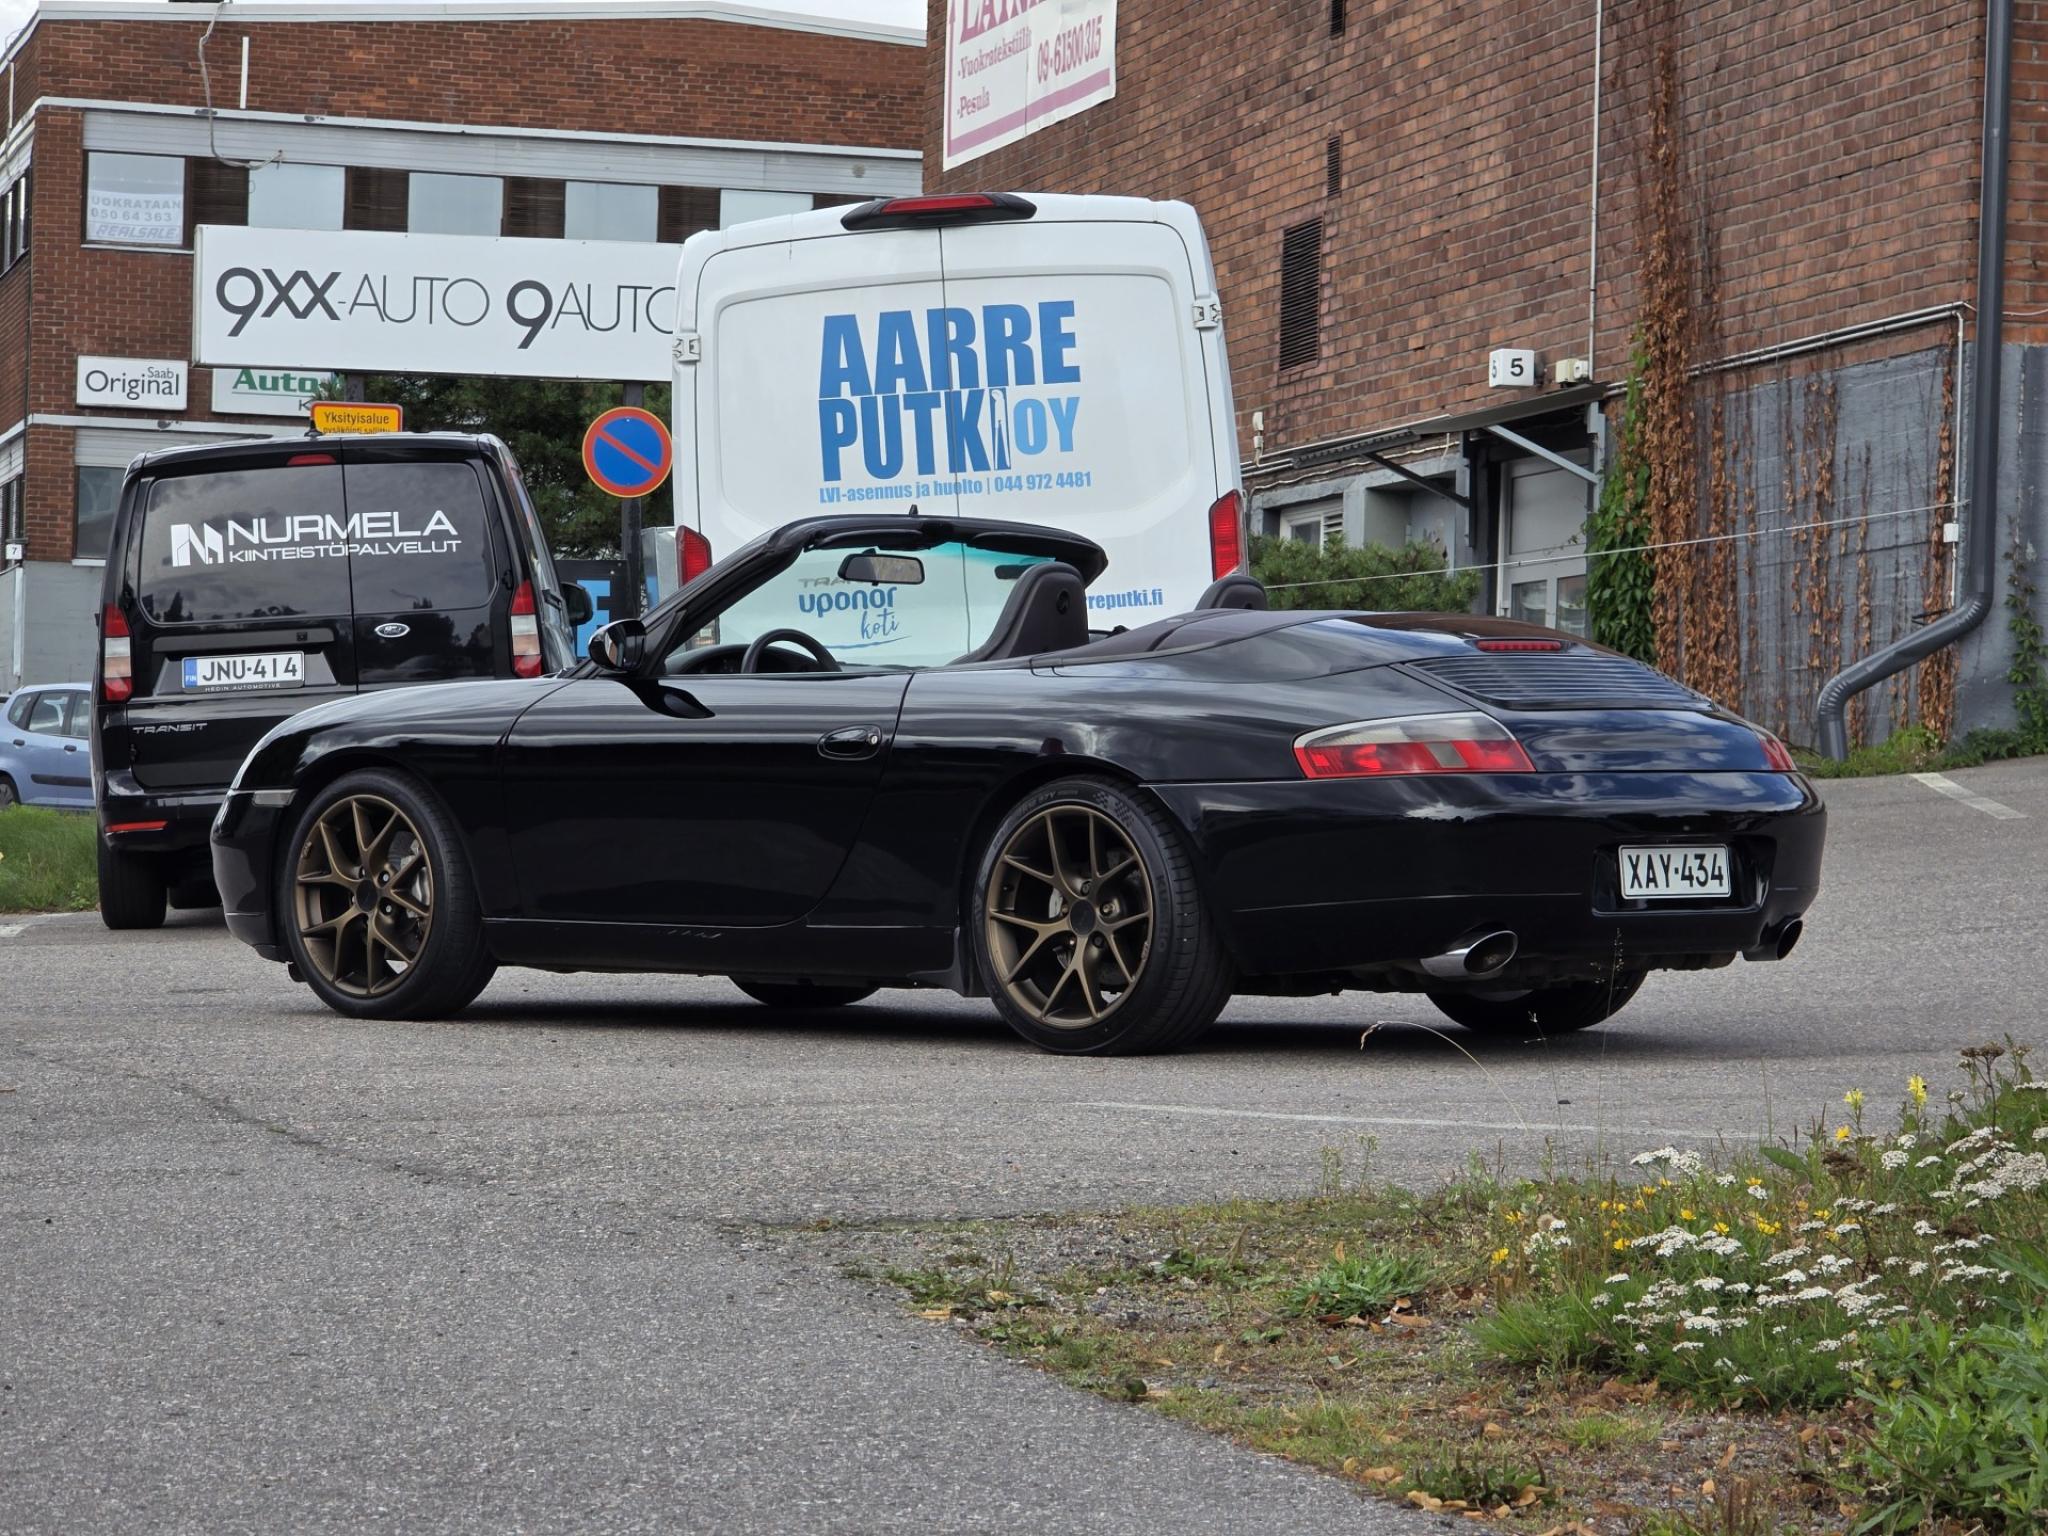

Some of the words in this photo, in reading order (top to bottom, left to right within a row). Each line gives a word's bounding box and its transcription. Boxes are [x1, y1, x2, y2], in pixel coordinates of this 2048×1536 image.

[819, 300, 1081, 398] AARRE
[147, 366, 175, 379] Saab
[1510, 357, 1524, 377] 5
[85, 370, 180, 401] Original
[324, 412, 390, 425] Yksityisalue
[1013, 396, 1081, 456] OY
[820, 484, 912, 503] LVI-asennus
[916, 482, 930, 499] ja
[934, 475, 982, 496] huolto
[994, 475, 1023, 492] 044
[1026, 473, 1053, 490] 972
[1056, 471, 1091, 488] 4481
[228, 510, 458, 546] NURMELA
[229, 540, 462, 563] KIINTEISTÖPALVELUT
[798, 586, 898, 618] uponor
[861, 608, 900, 639] koti
[202, 656, 298, 682] JNU-414
[133, 722, 207, 734] TRANSIT
[1627, 853, 1724, 889] XAY-434
